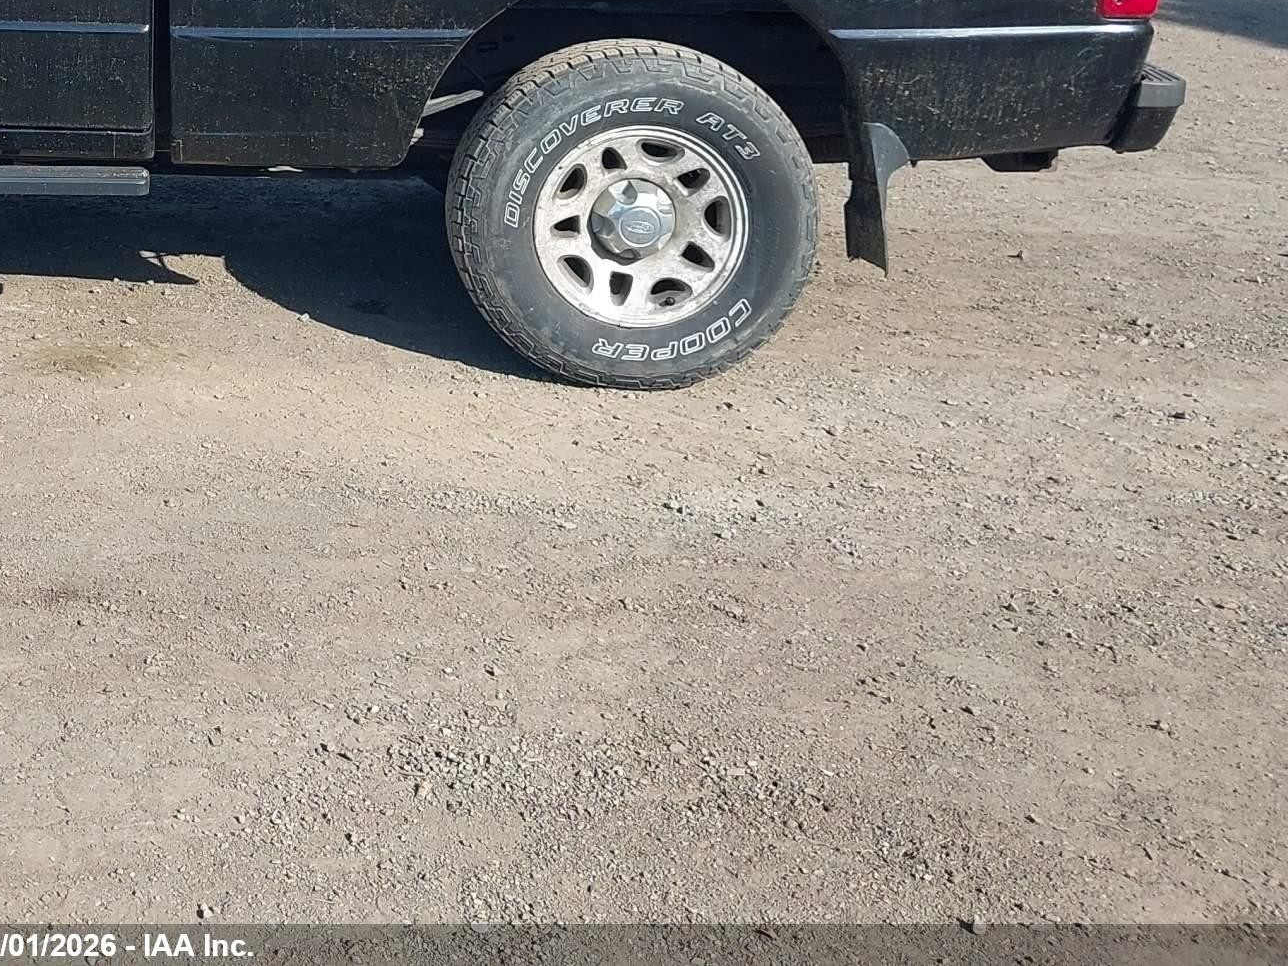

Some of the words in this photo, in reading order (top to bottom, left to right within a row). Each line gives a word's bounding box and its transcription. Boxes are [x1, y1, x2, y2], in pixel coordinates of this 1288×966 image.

[504, 97, 684, 228] DISCOVERER
[696, 112, 761, 161] AT3
[592, 298, 753, 362] COOPER
